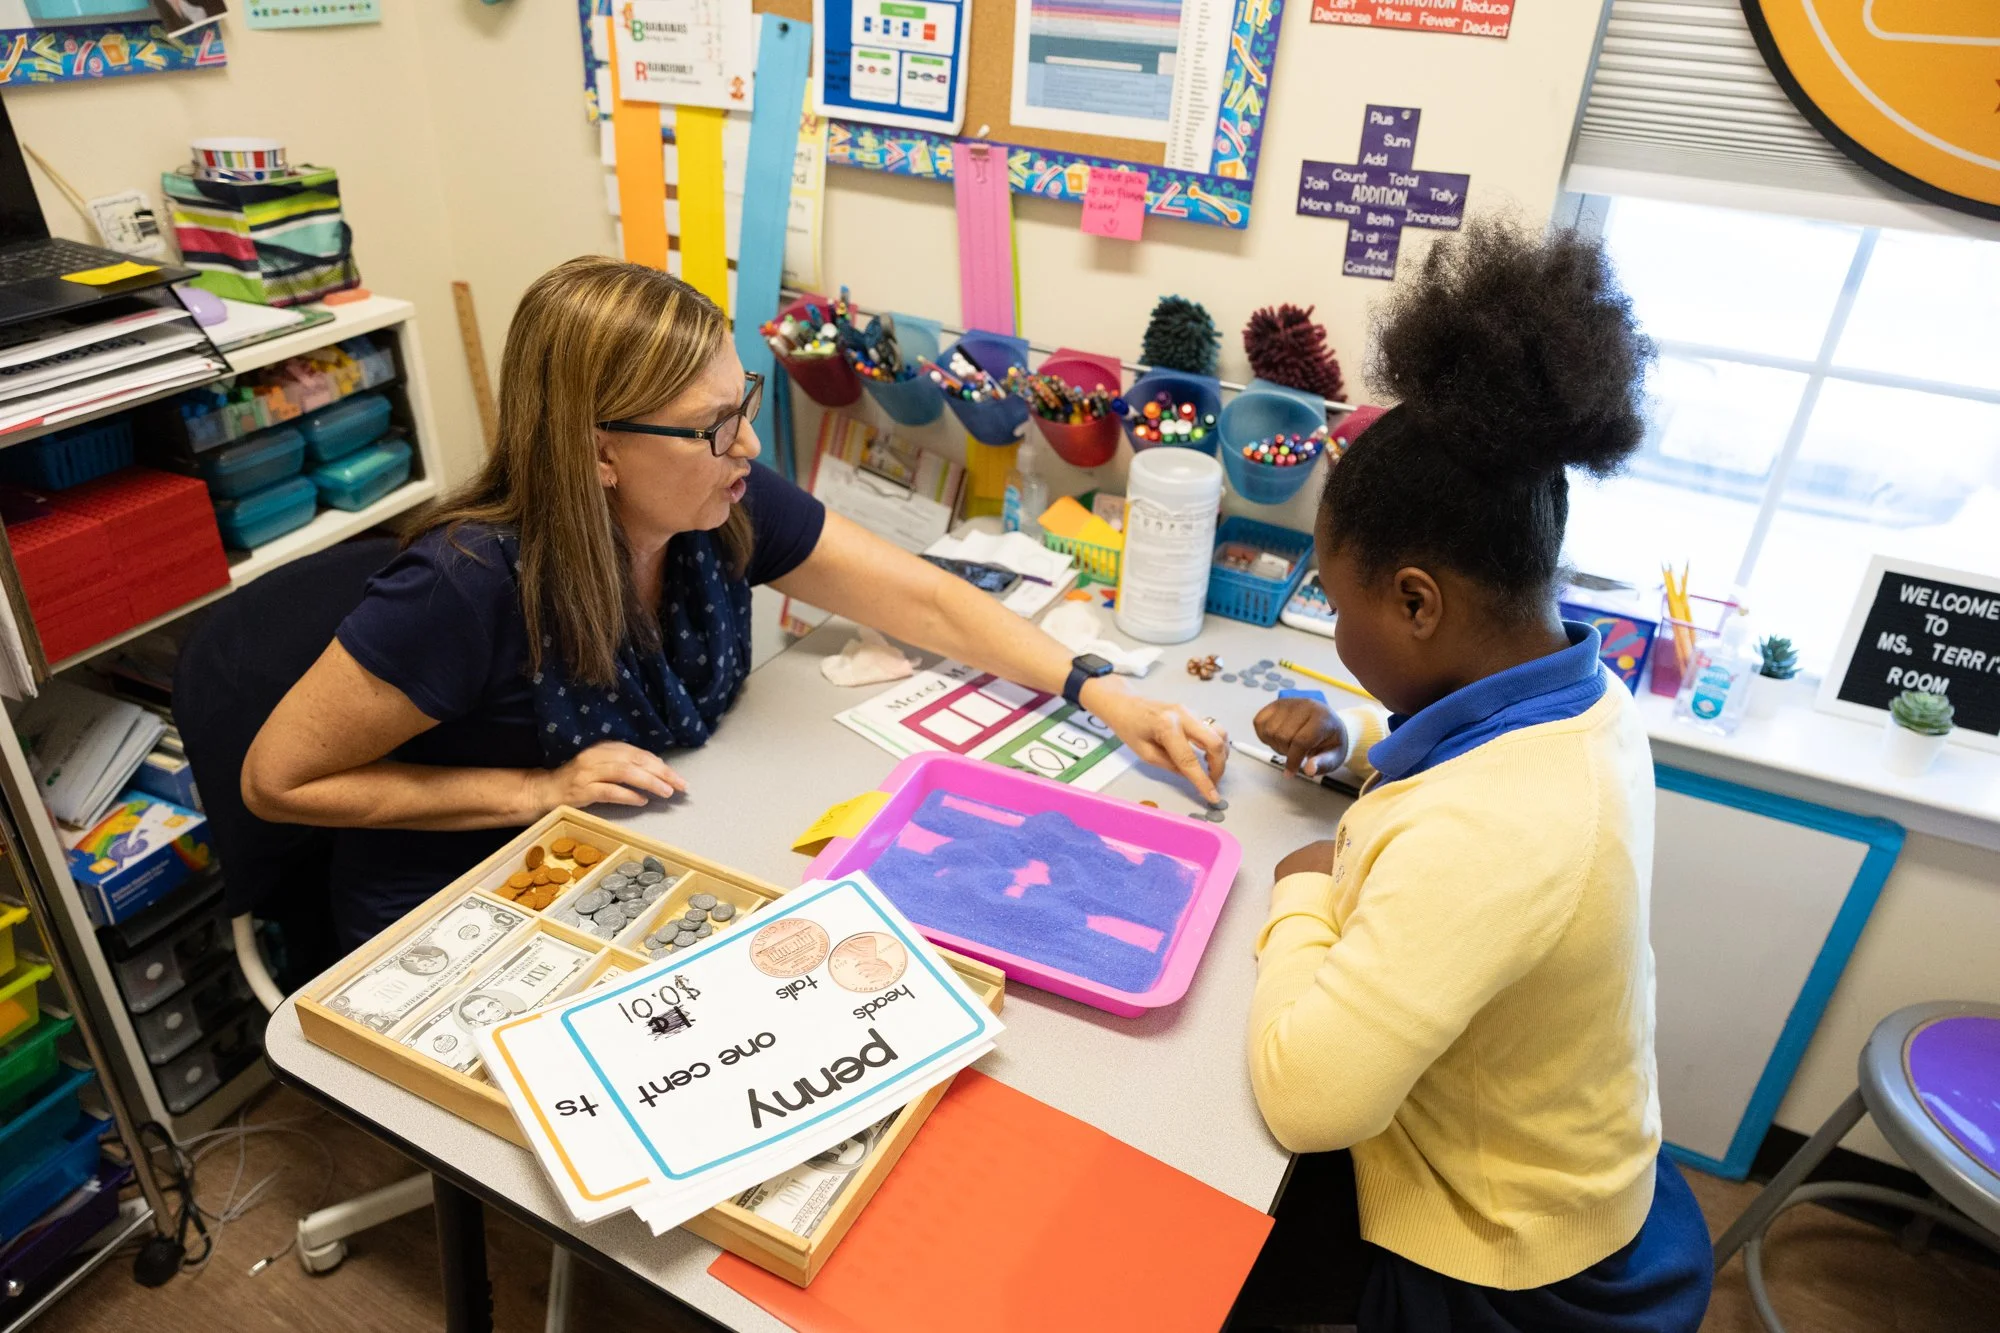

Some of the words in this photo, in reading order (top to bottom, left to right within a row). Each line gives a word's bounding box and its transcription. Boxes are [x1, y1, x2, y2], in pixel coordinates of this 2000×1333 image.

[1461, 0, 1509, 15] Reduce
[1314, 8, 1372, 24] Decrease
[1376, 7, 1412, 22] Minus
[1419, 13, 1461, 28] Fewer
[1461, 20, 1509, 36] Deduct
[1370, 111, 1394, 126] Plus
[1383, 133, 1411, 148] Sum
[1363, 152, 1388, 166] Add
[1304, 177, 1330, 191] Join
[1332, 169, 1368, 184] Count
[1389, 172, 1419, 187] Total
[1301, 198, 1332, 213] More
[1335, 201, 1361, 215] than
[1351, 184, 1409, 207] ADDITION
[1429, 188, 1458, 204] Tally
[1366, 212, 1394, 227] Both
[1405, 209, 1460, 228] Increase
[1350, 229, 1364, 242] In
[1366, 229, 1380, 243] all
[1364, 249, 1388, 262] And
[1344, 261, 1394, 277] Combine
[1900, 583, 2000, 620] WELCOME
[1925, 613, 1949, 637] TO
[1876, 631, 1913, 655] MS.
[1886, 666, 1950, 695] ROOM
[885, 680, 948, 712] Money
[520, 961, 556, 988] FIVE
[618, 974, 701, 1023] $0.01
[776, 975, 818, 1001] tails
[853, 984, 915, 1022] heads
[718, 1031, 776, 1066] one
[638, 1062, 711, 1107] cent
[748, 1027, 899, 1129] penny
